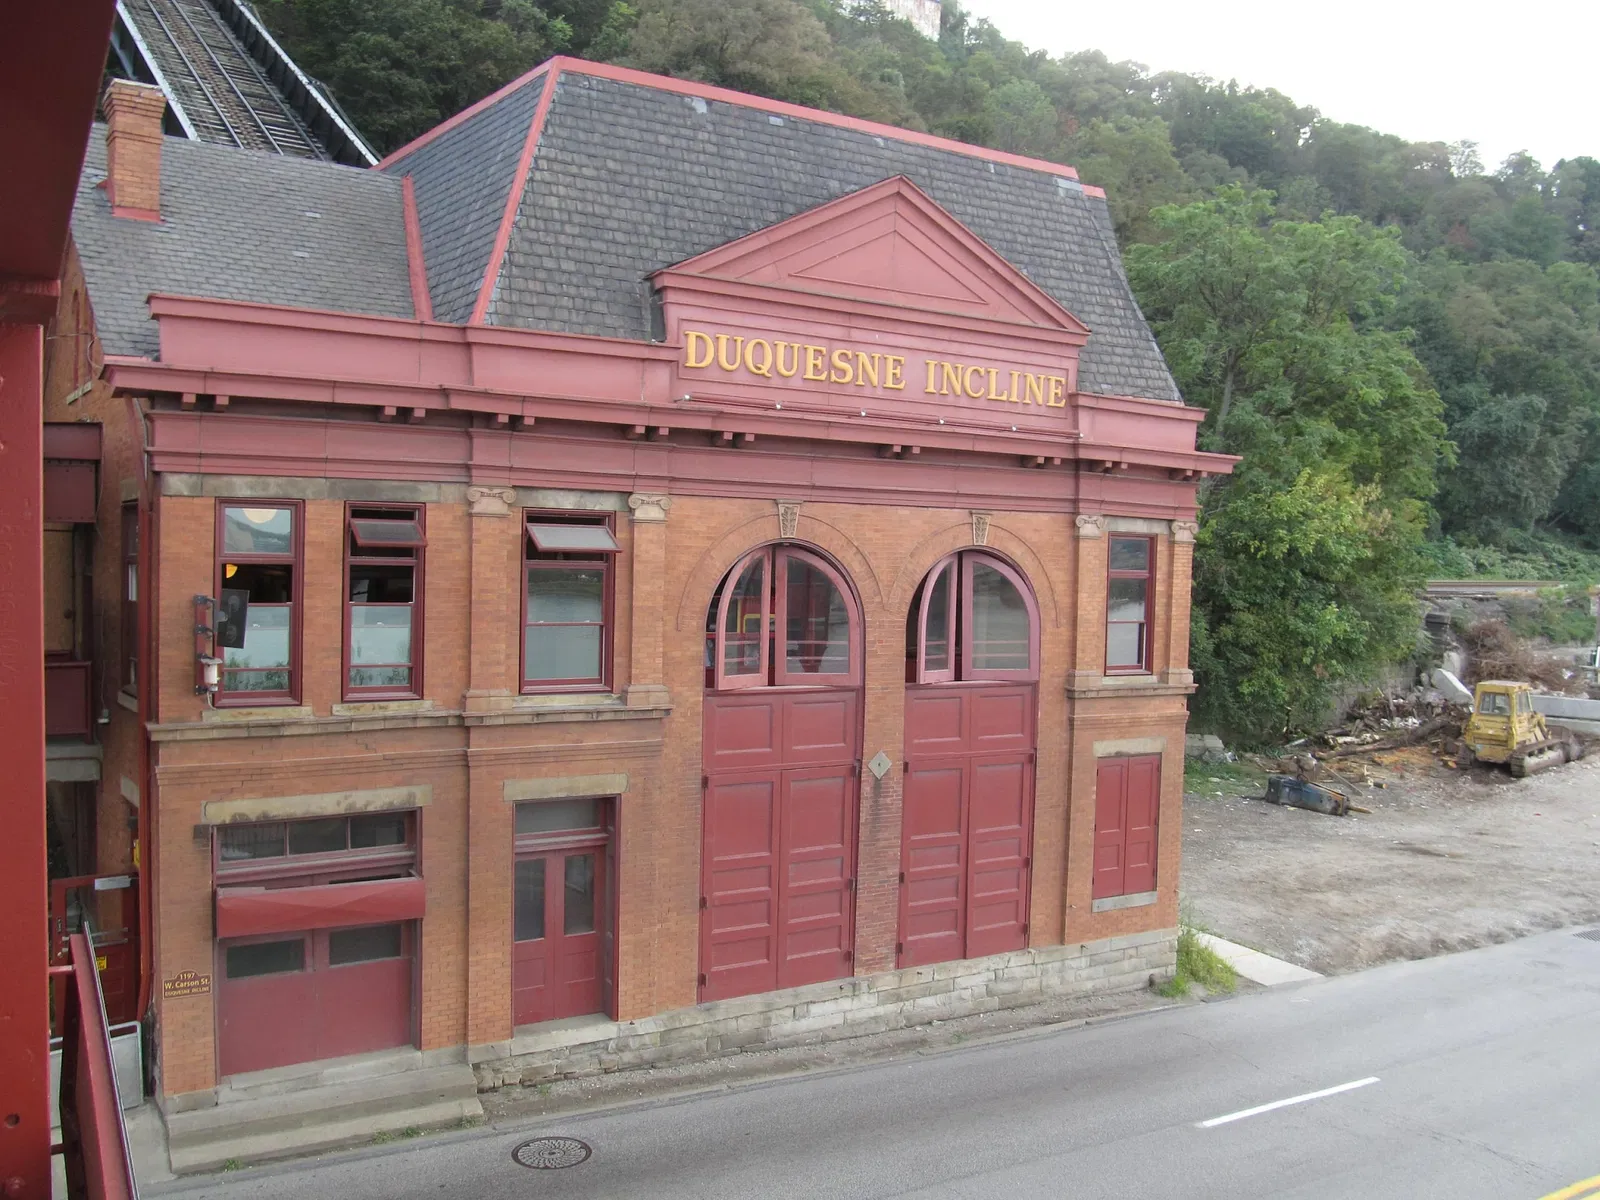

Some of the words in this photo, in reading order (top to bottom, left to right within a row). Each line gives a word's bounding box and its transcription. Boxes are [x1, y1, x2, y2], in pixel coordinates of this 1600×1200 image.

[684, 330, 906, 389] DUQUESNE
[925, 360, 1067, 408] INCLINE
[175, 980, 199, 988] Carson
